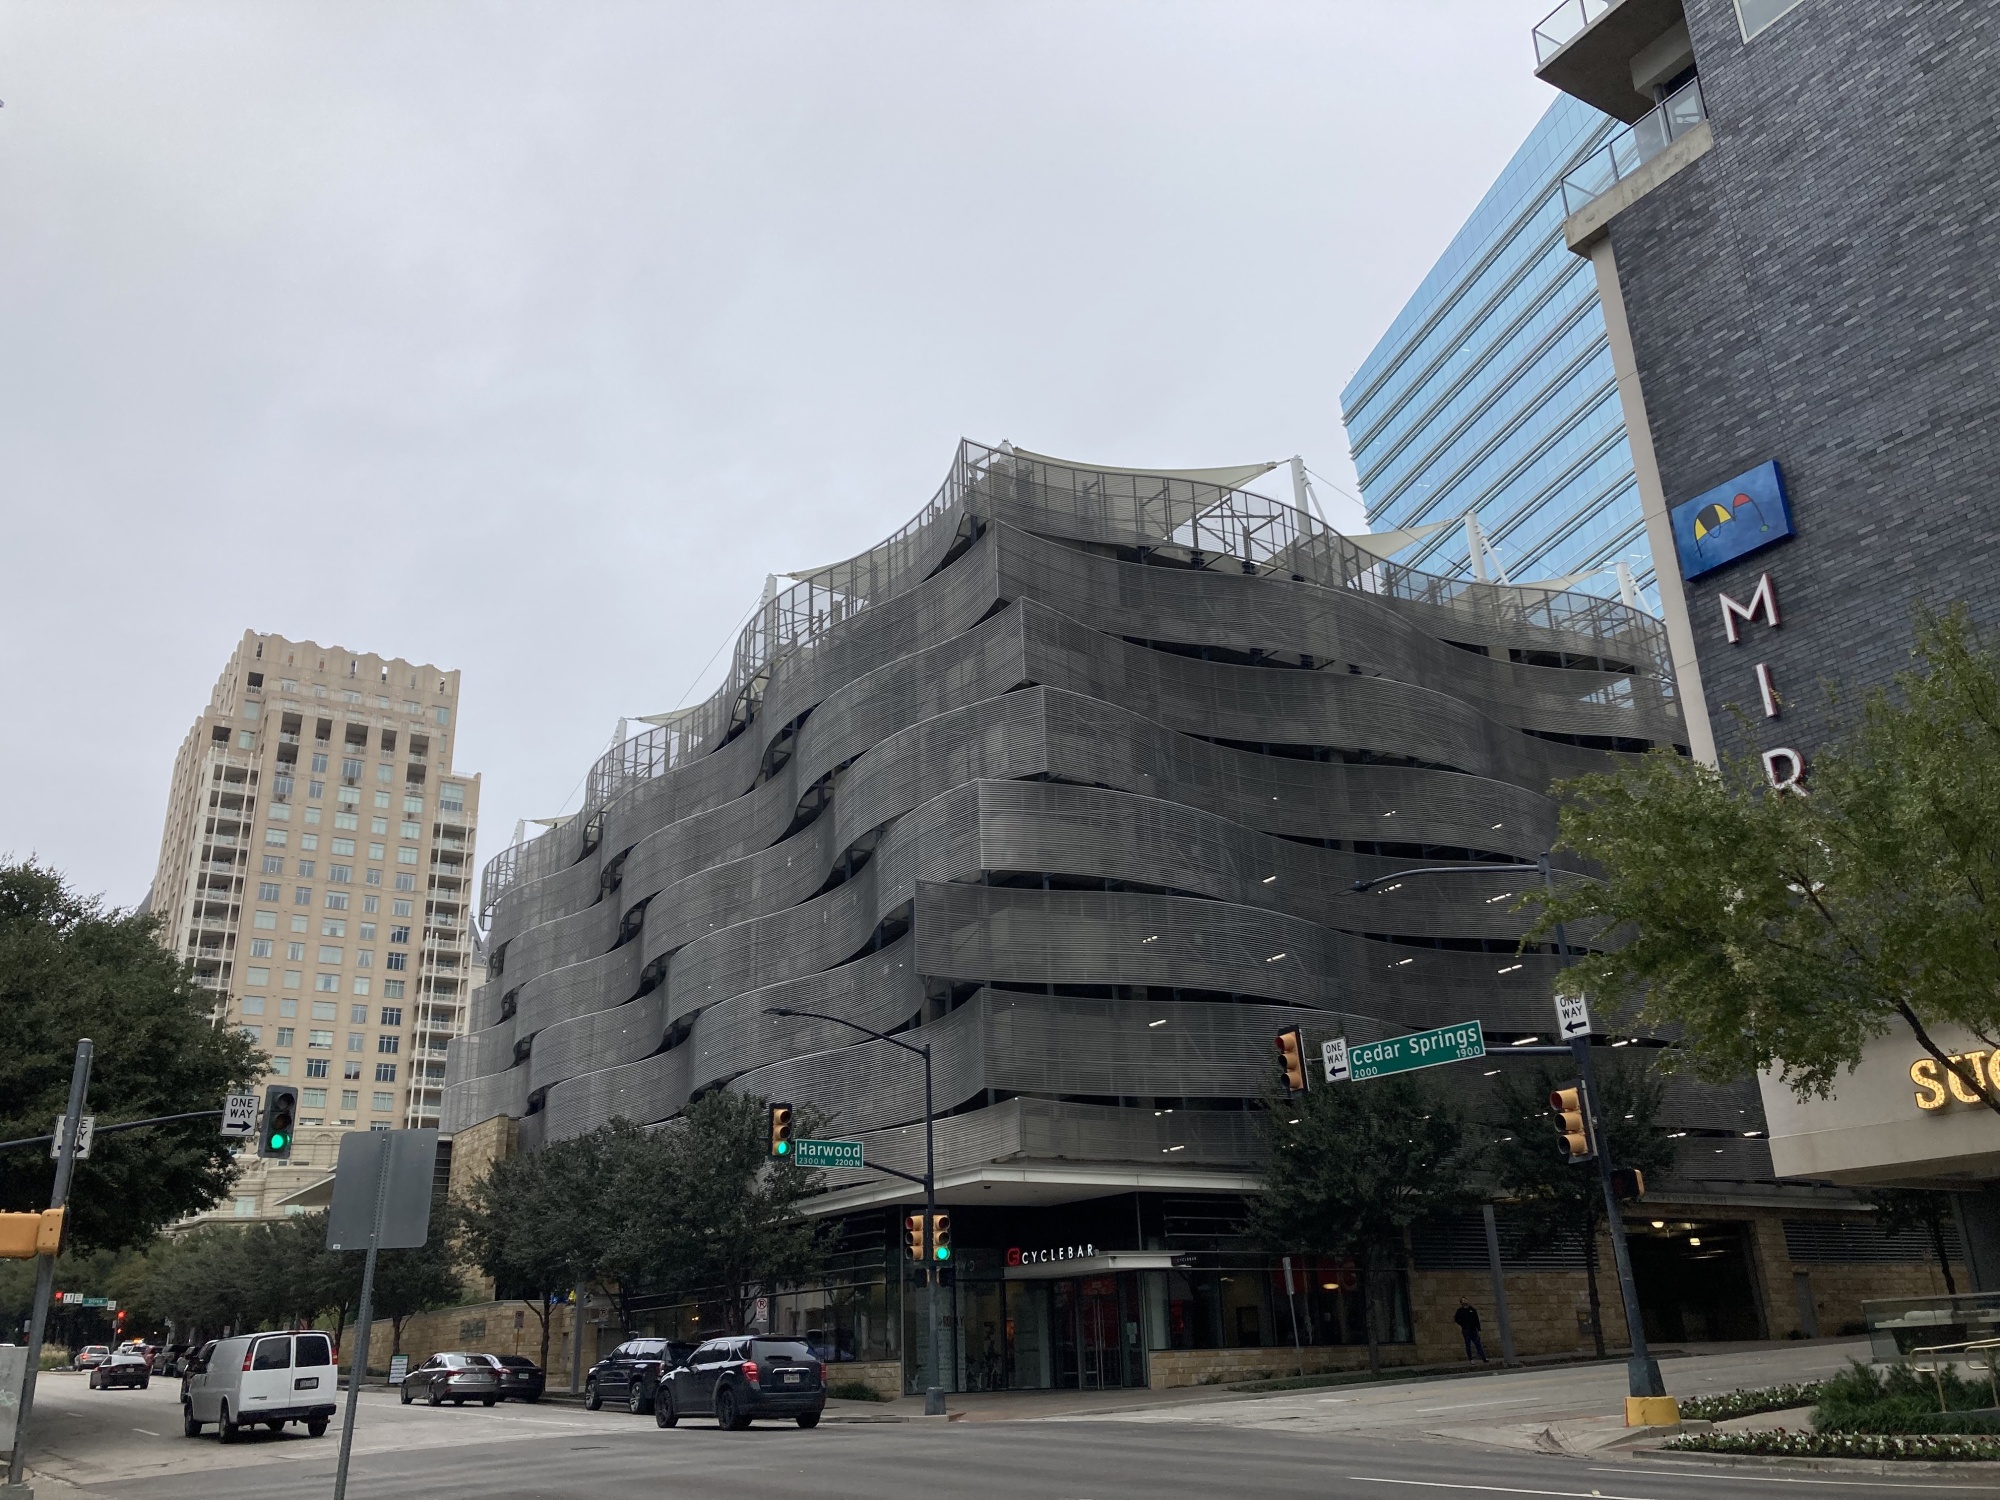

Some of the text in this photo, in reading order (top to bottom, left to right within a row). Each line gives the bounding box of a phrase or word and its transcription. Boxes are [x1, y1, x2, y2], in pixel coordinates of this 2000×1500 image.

[1719, 573, 1826, 888] MIR
[1562, 1005, 1582, 1019] WAY
[1325, 1042, 1342, 1054] ONE
[1352, 1027, 1478, 1065] Cedar Springs
[1327, 1053, 1344, 1065] WAY
[1354, 1046, 1480, 1079] 2000 1900
[231, 1098, 254, 1108] ONE
[230, 1109, 254, 1119] WAY
[799, 1143, 860, 1158] Harwood
[1022, 1244, 1093, 1265] CYCLEBAR
